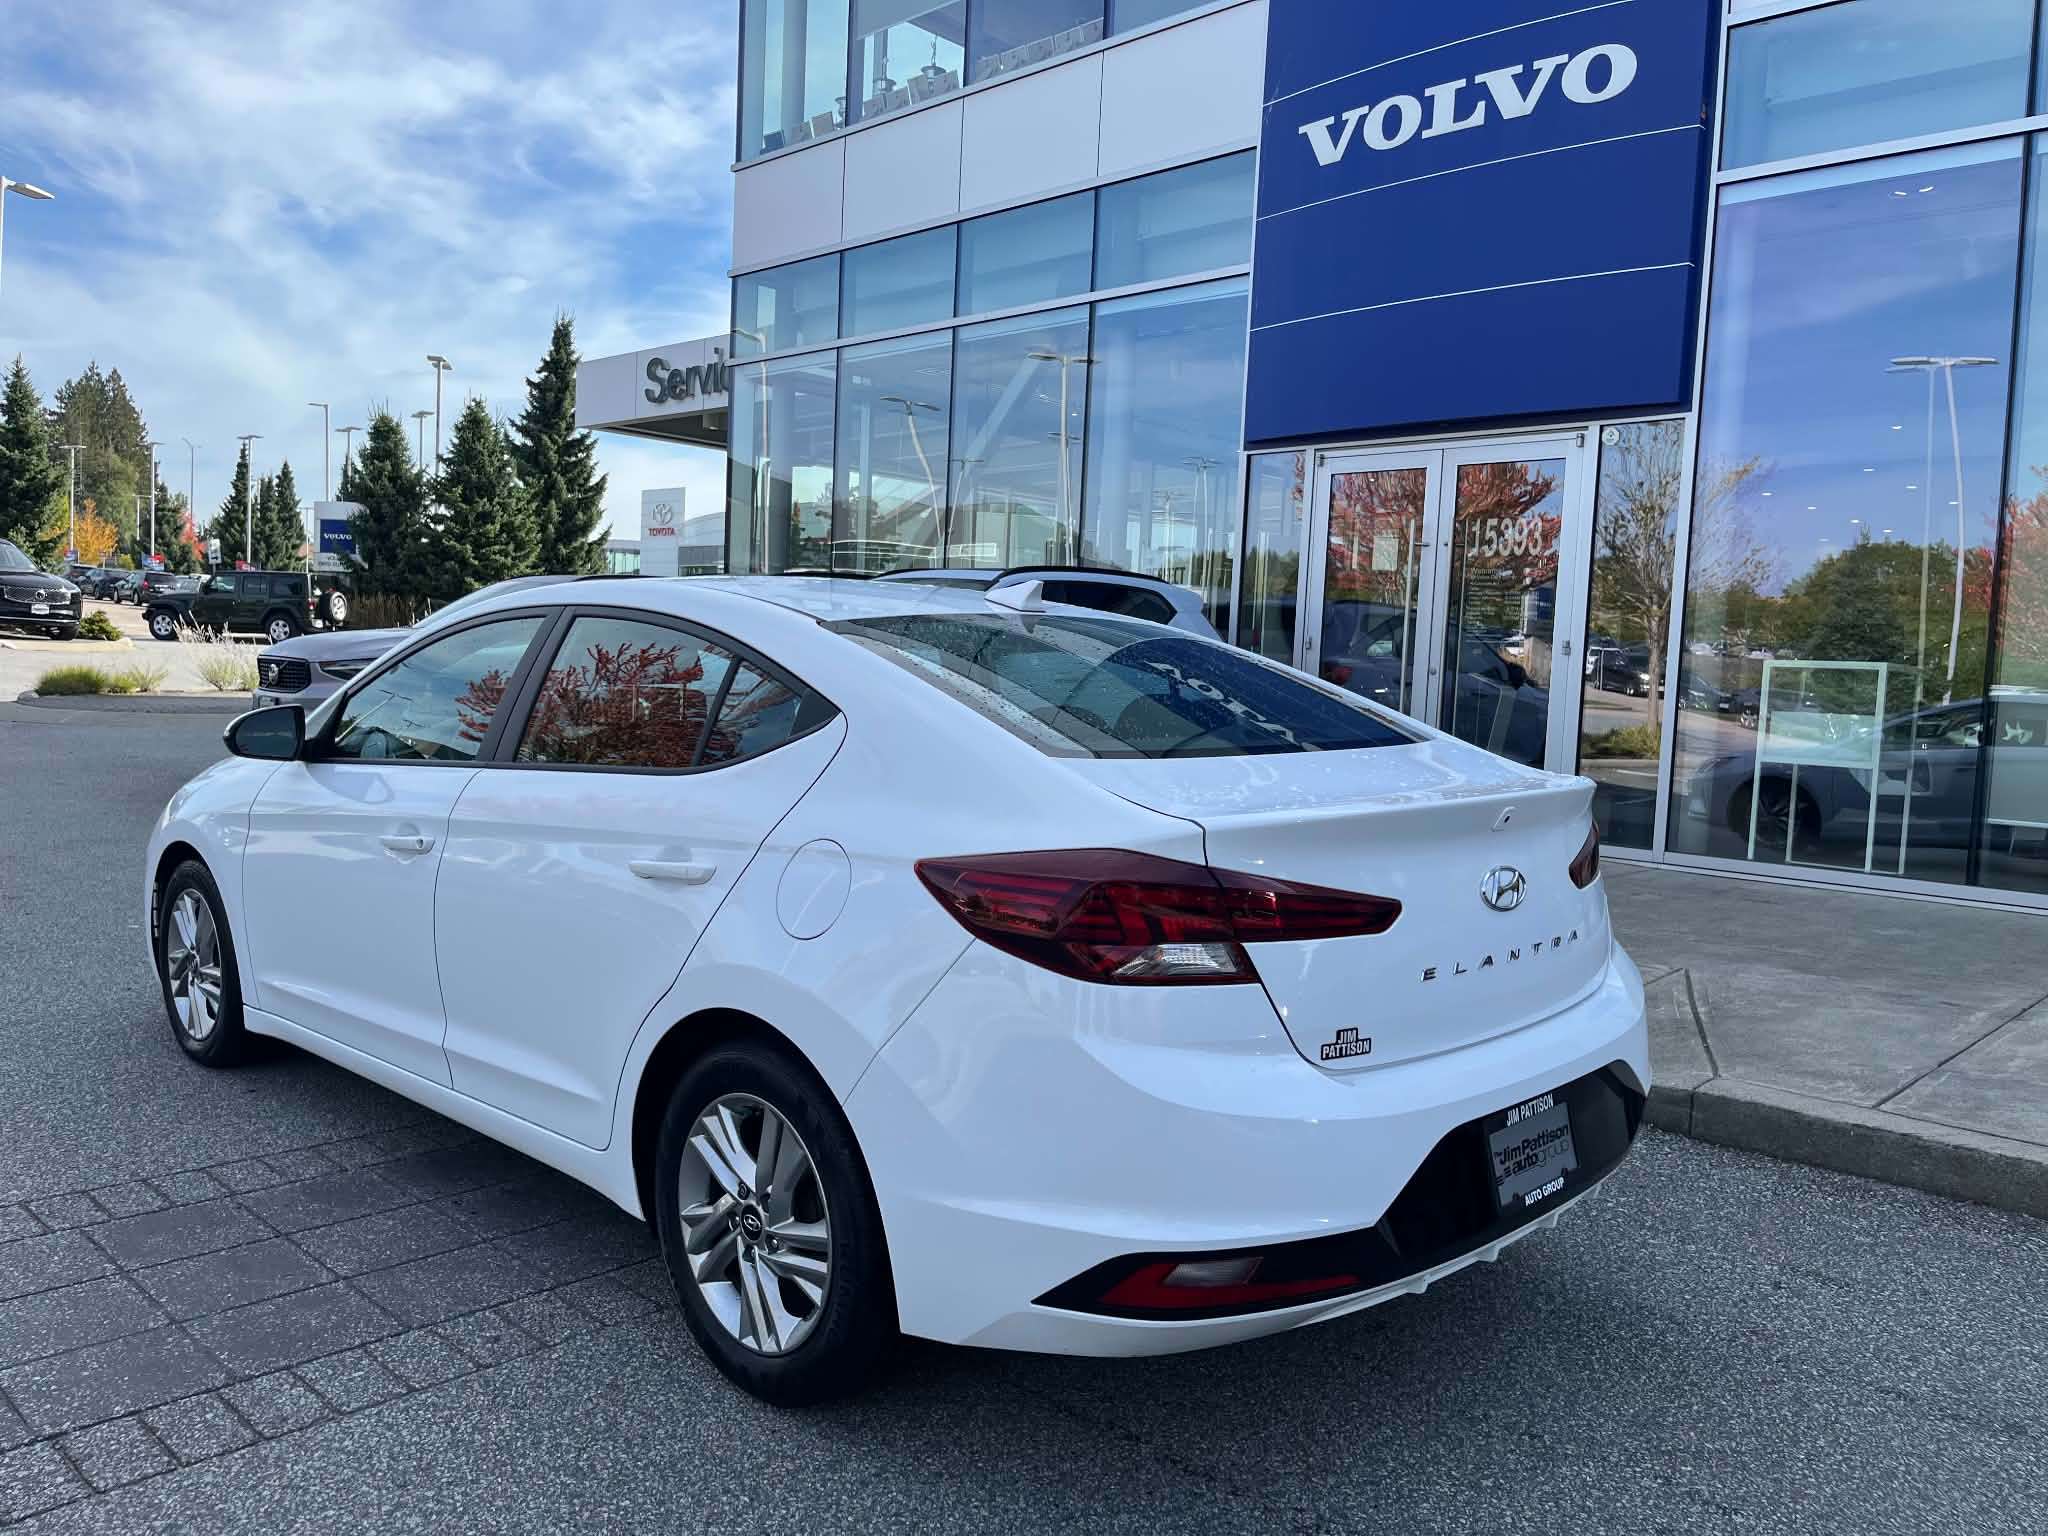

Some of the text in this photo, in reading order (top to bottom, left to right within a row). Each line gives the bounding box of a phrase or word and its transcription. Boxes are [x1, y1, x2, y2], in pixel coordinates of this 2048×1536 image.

[1298, 44, 1637, 166] VOLVO
[324, 533, 352, 541] VOLVO
[648, 527, 675, 536] TOYOTA
[1420, 929, 1578, 981] ELANTRA
[1322, 1039, 1370, 1058] PATTISON
[1337, 1031, 1357, 1044] JIM
[1506, 1094, 1553, 1126] JIM PATTISON
[1525, 1177, 1564, 1206] AUTO GROUP
